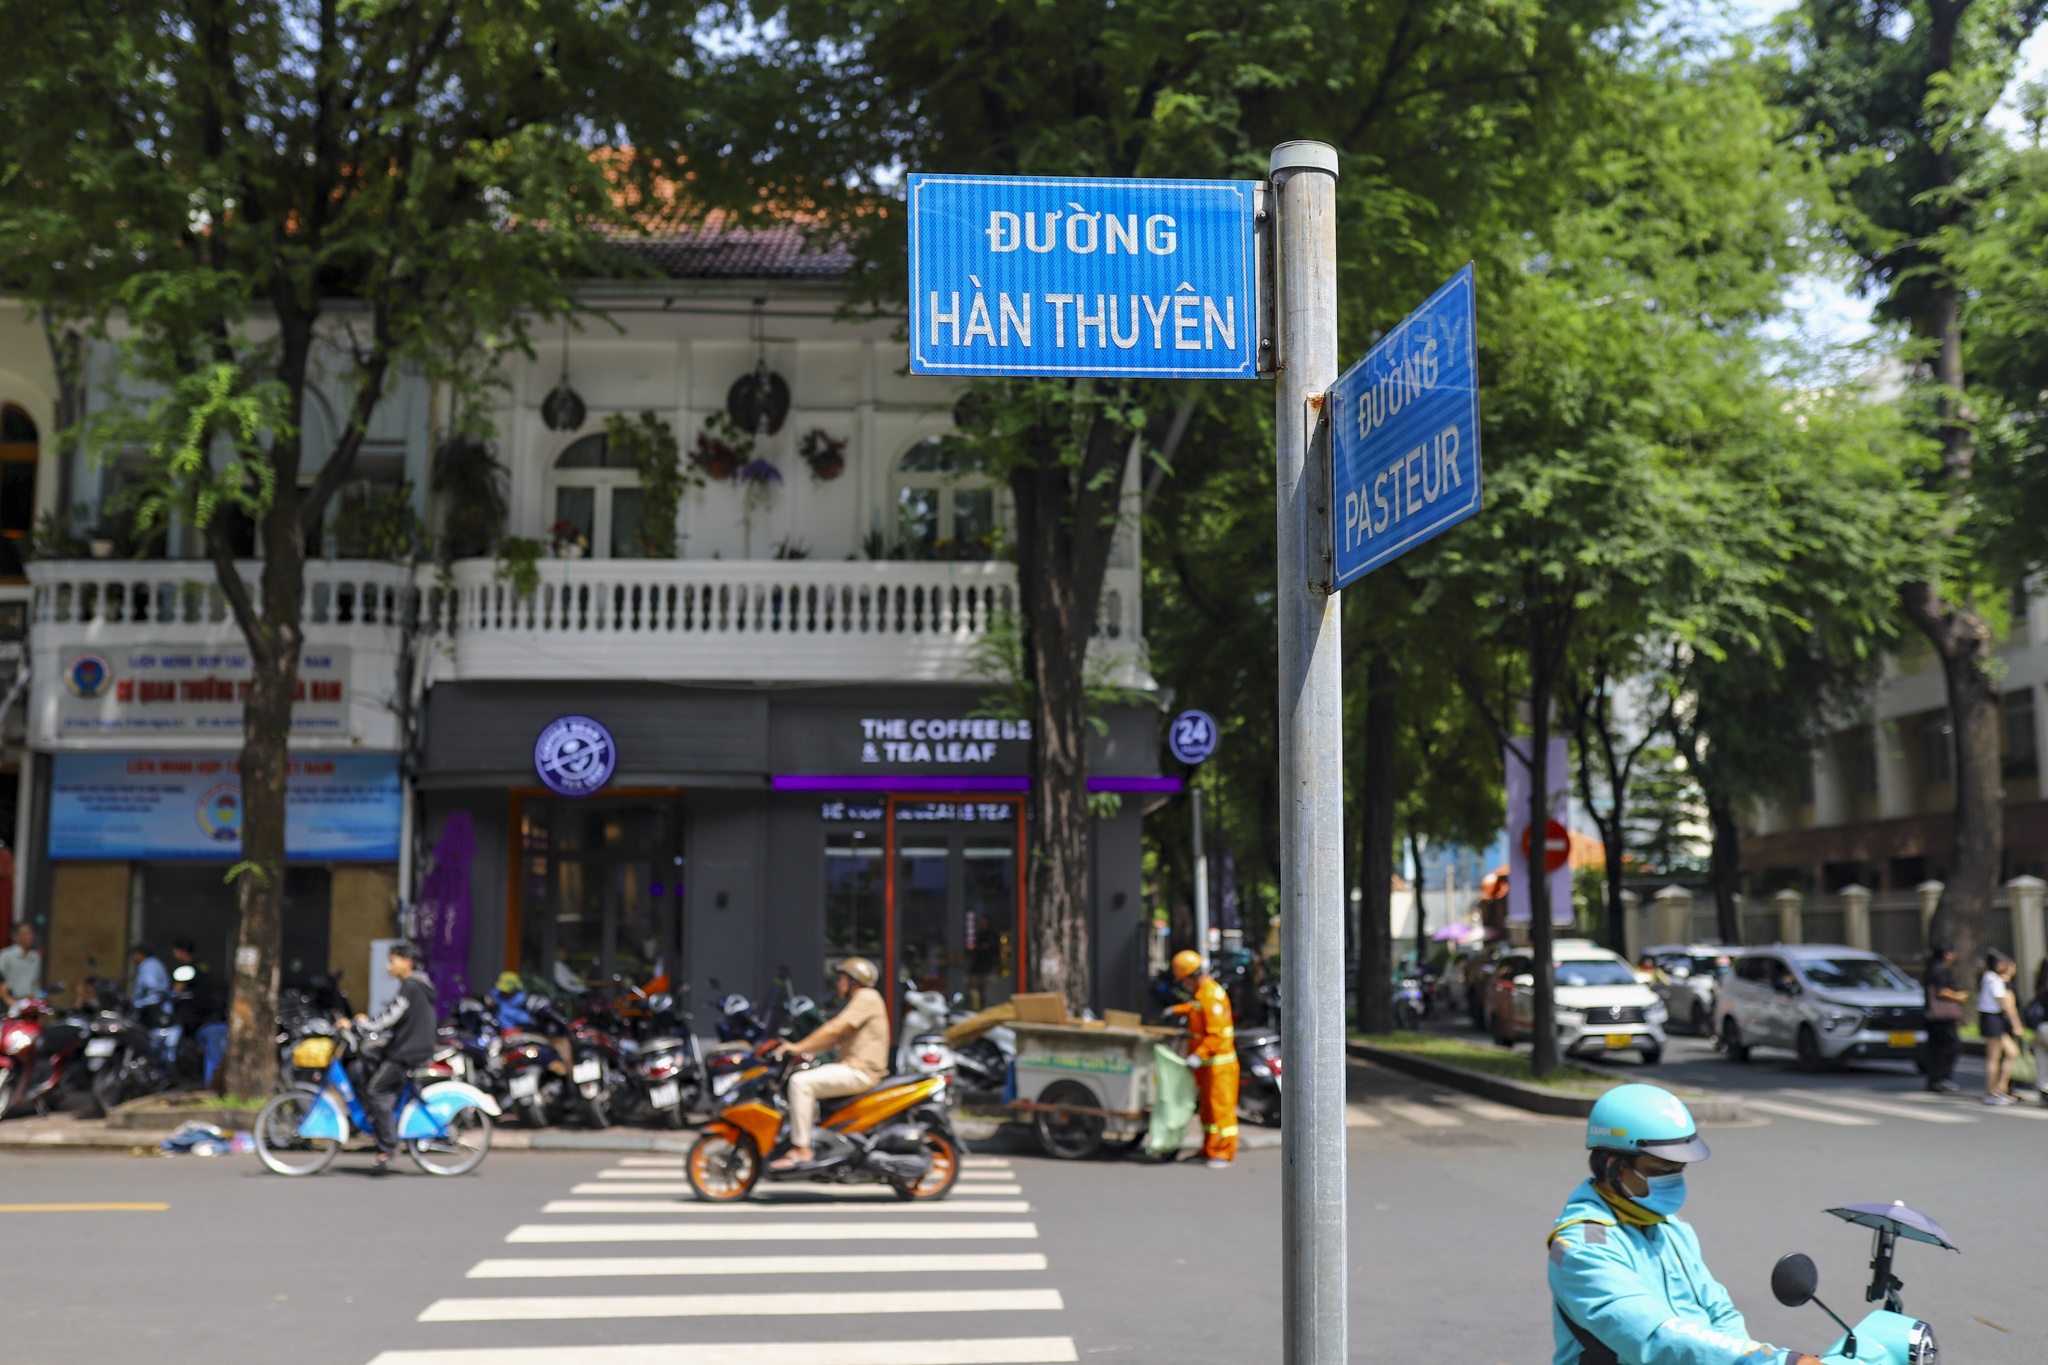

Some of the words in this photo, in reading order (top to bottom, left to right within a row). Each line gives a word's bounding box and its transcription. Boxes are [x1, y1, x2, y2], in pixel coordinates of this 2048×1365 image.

[985, 203, 1177, 255] ĐƯỜNG
[930, 275, 1031, 347] HÀN
[1045, 282, 1236, 350] THUYÊN
[1358, 338, 1438, 440] ĐƯỜNG
[1345, 424, 1462, 552] PASTEUR
[860, 718, 908, 740] THE
[908, 718, 1000, 741] COFFEE
[1001, 719, 1033, 741] BE
[861, 741, 880, 763] &
[882, 741, 932, 763] TEA
[935, 741, 997, 763] LEAF
[1177, 719, 1209, 745] 24
